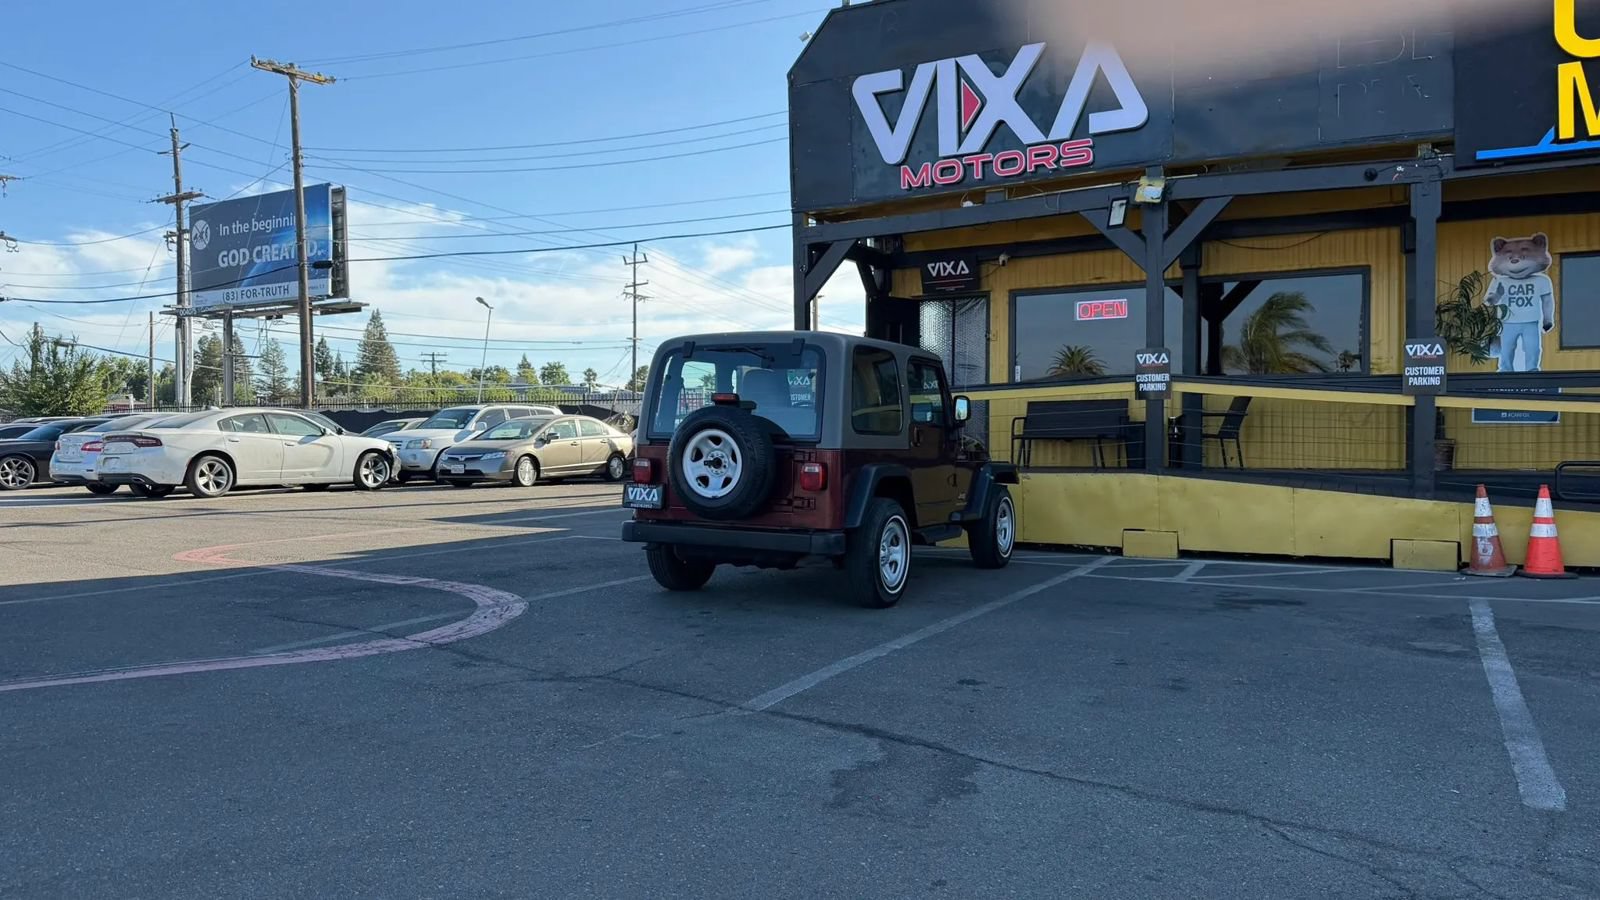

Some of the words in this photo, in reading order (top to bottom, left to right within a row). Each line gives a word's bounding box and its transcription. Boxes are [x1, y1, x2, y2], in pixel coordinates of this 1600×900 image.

[851, 40, 1149, 165] VIXA
[900, 138, 1094, 190] MOTORS
[219, 223, 230, 236] In
[232, 220, 250, 234] the
[218, 247, 250, 268] GOD
[252, 239, 322, 263] CREATD.
[927, 260, 970, 277] VIXA
[222, 290, 239, 304] (83)
[240, 284, 290, 300] FOR-TRUTH
[1508, 284, 1535, 296] CAR
[1508, 296, 1534, 308] FOX
[1079, 301, 1126, 318] OPEN
[1405, 343, 1445, 356] VIXA
[1136, 352, 1169, 364] VIXA
[1136, 373, 1170, 382] CUSTOMER
[1404, 366, 1445, 376] CUSTOMER
[1139, 382, 1167, 391] PARKING
[1408, 376, 1441, 386] PARKING
[627, 487, 659, 502] VIXA
